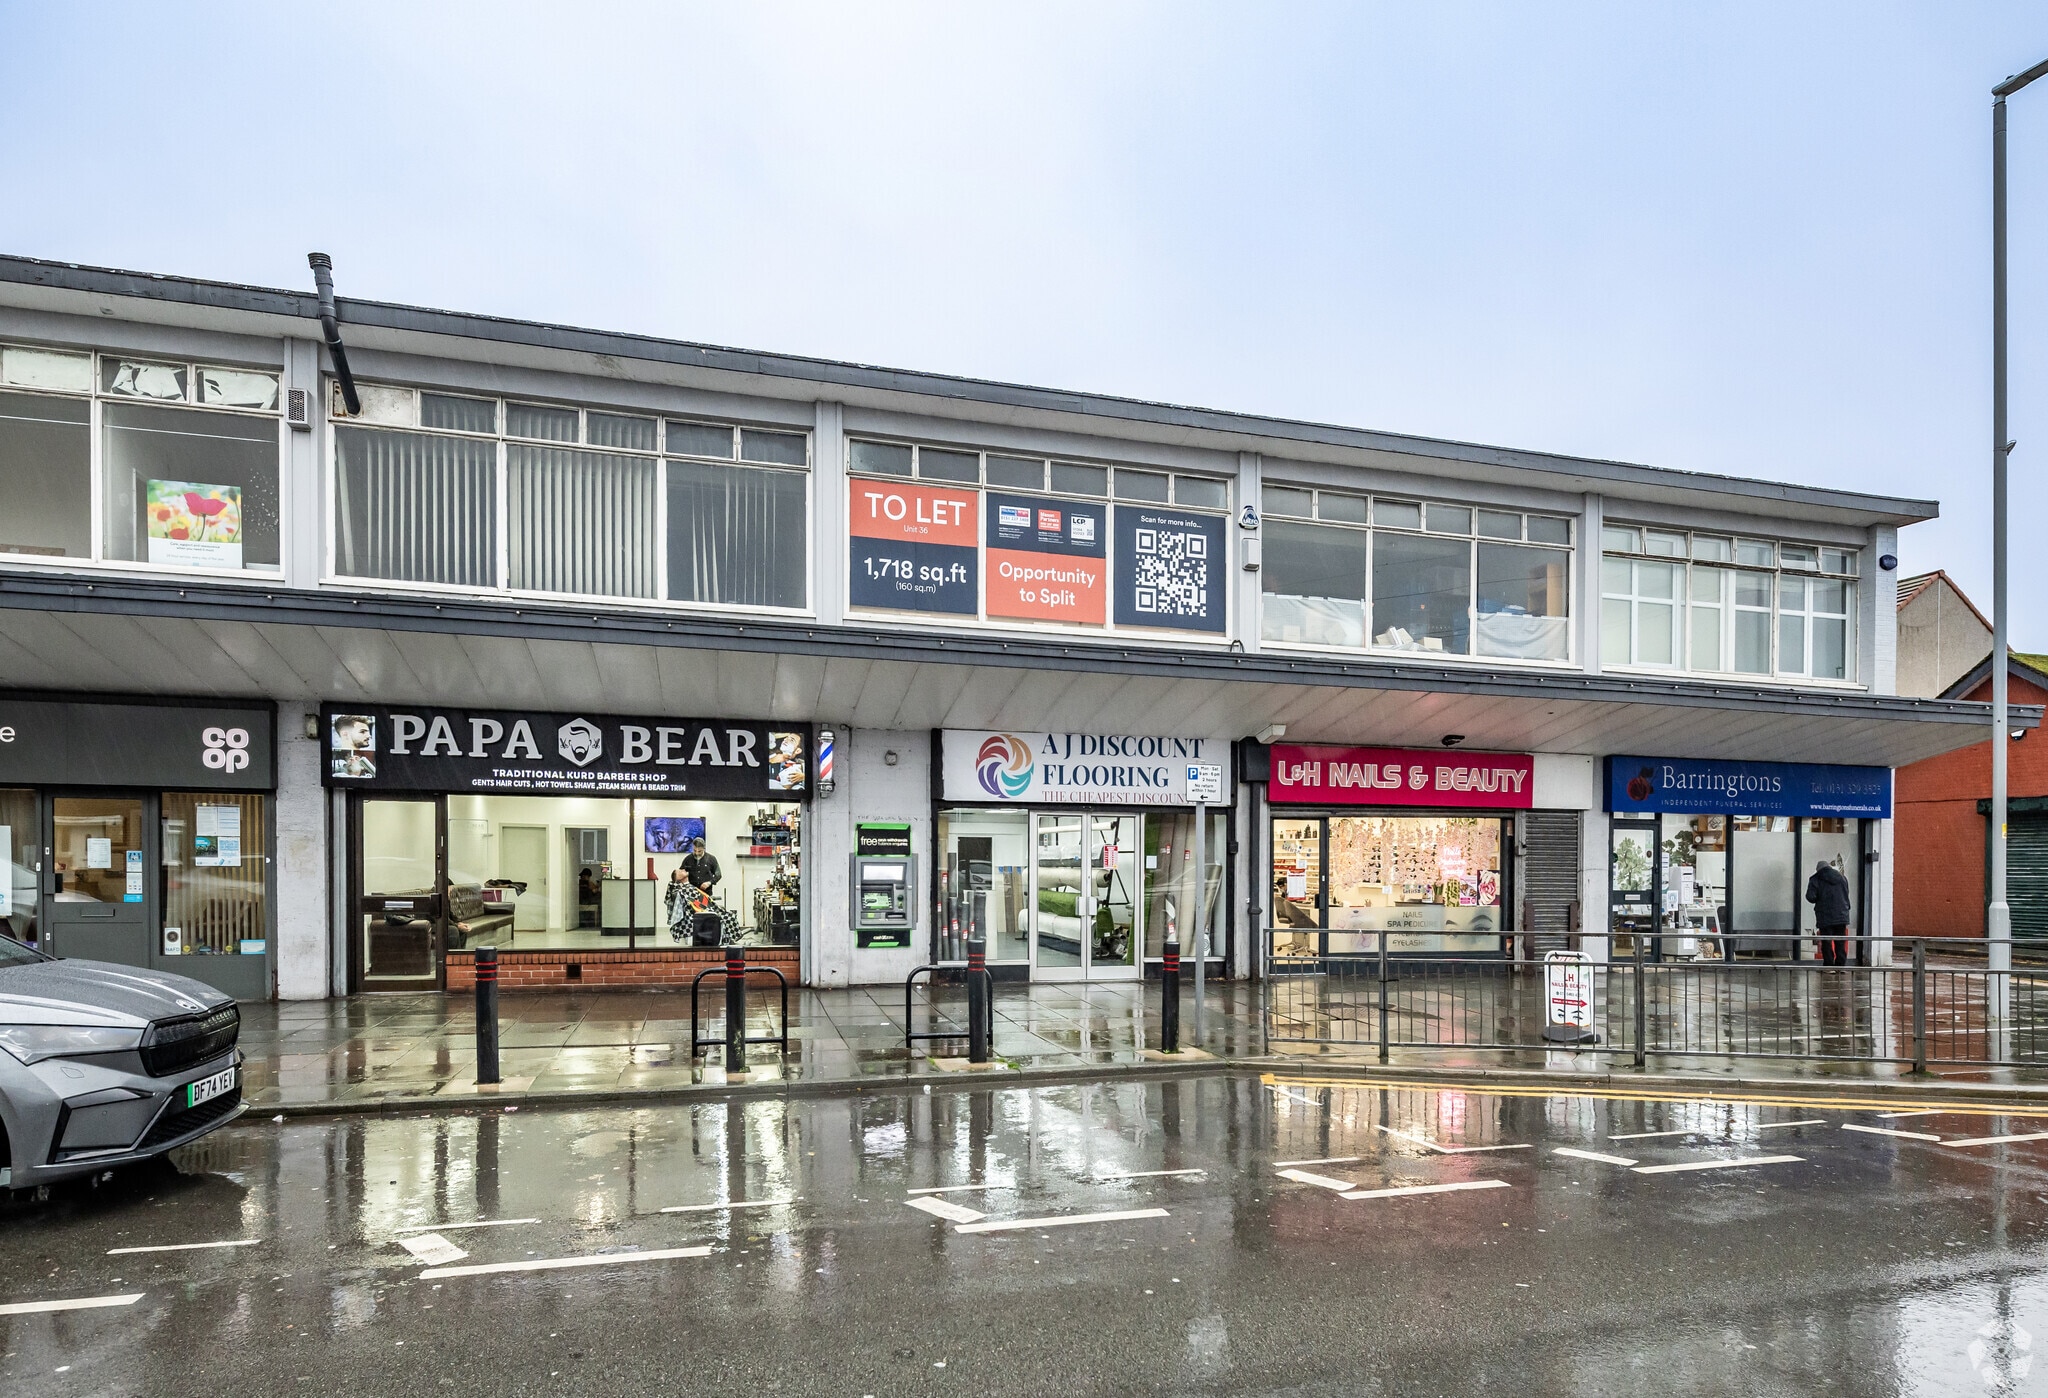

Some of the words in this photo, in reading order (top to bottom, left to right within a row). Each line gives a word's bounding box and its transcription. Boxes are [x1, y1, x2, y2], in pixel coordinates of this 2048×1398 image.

[865, 492, 907, 521] TO
[916, 498, 967, 526] LET
[1072, 517, 1086, 525] LCP
[1140, 515, 1157, 524] Scan
[1157, 517, 1167, 525] for
[1167, 519, 1184, 527] more
[903, 525, 918, 534] Unit
[919, 526, 929, 535] 36
[864, 557, 914, 580] 1,718
[920, 562, 967, 586] sq.ft
[999, 561, 1096, 588] Opportunity
[896, 581, 913, 592] (160
[914, 583, 936, 594] sq.m)
[1019, 587, 1036, 603] to
[1040, 588, 1076, 608] Split
[389, 714, 543, 760] PAPA
[619, 725, 760, 767] BEAR
[1080, 735, 1205, 759] DISCOUNT
[493, 768, 565, 779] TRADITIONAL
[566, 771, 595, 780] KURD
[597, 772, 637, 781] BARBER
[639, 773, 667, 781] SHOP
[1043, 764, 1169, 788] FLOORING
[1329, 762, 1402, 789] NAILS
[1409, 765, 1428, 790] &
[1435, 766, 1527, 792] BEAUTY
[1662, 765, 1781, 798] Barringtons
[472, 779, 495, 787] GENTS
[550, 781, 573, 789] TOWEL
[620, 783, 641, 791] SHAVE
[670, 784, 686, 792] TRIM
[1041, 790, 1065, 802] THE
[1069, 791, 1131, 803] CHEAPEST
[1133, 793, 1188, 804] DISCOUN
[1661, 799, 1712, 807] INDEPENDENT
[1715, 800, 1747, 808] FUNERAL
[860, 835, 877, 846] free
[1387, 920, 1402, 928] SPA
[1403, 920, 1439, 928] PEDICURE
[1392, 939, 1433, 947] EYELASHES
[194, 1077, 217, 1102] DF74
